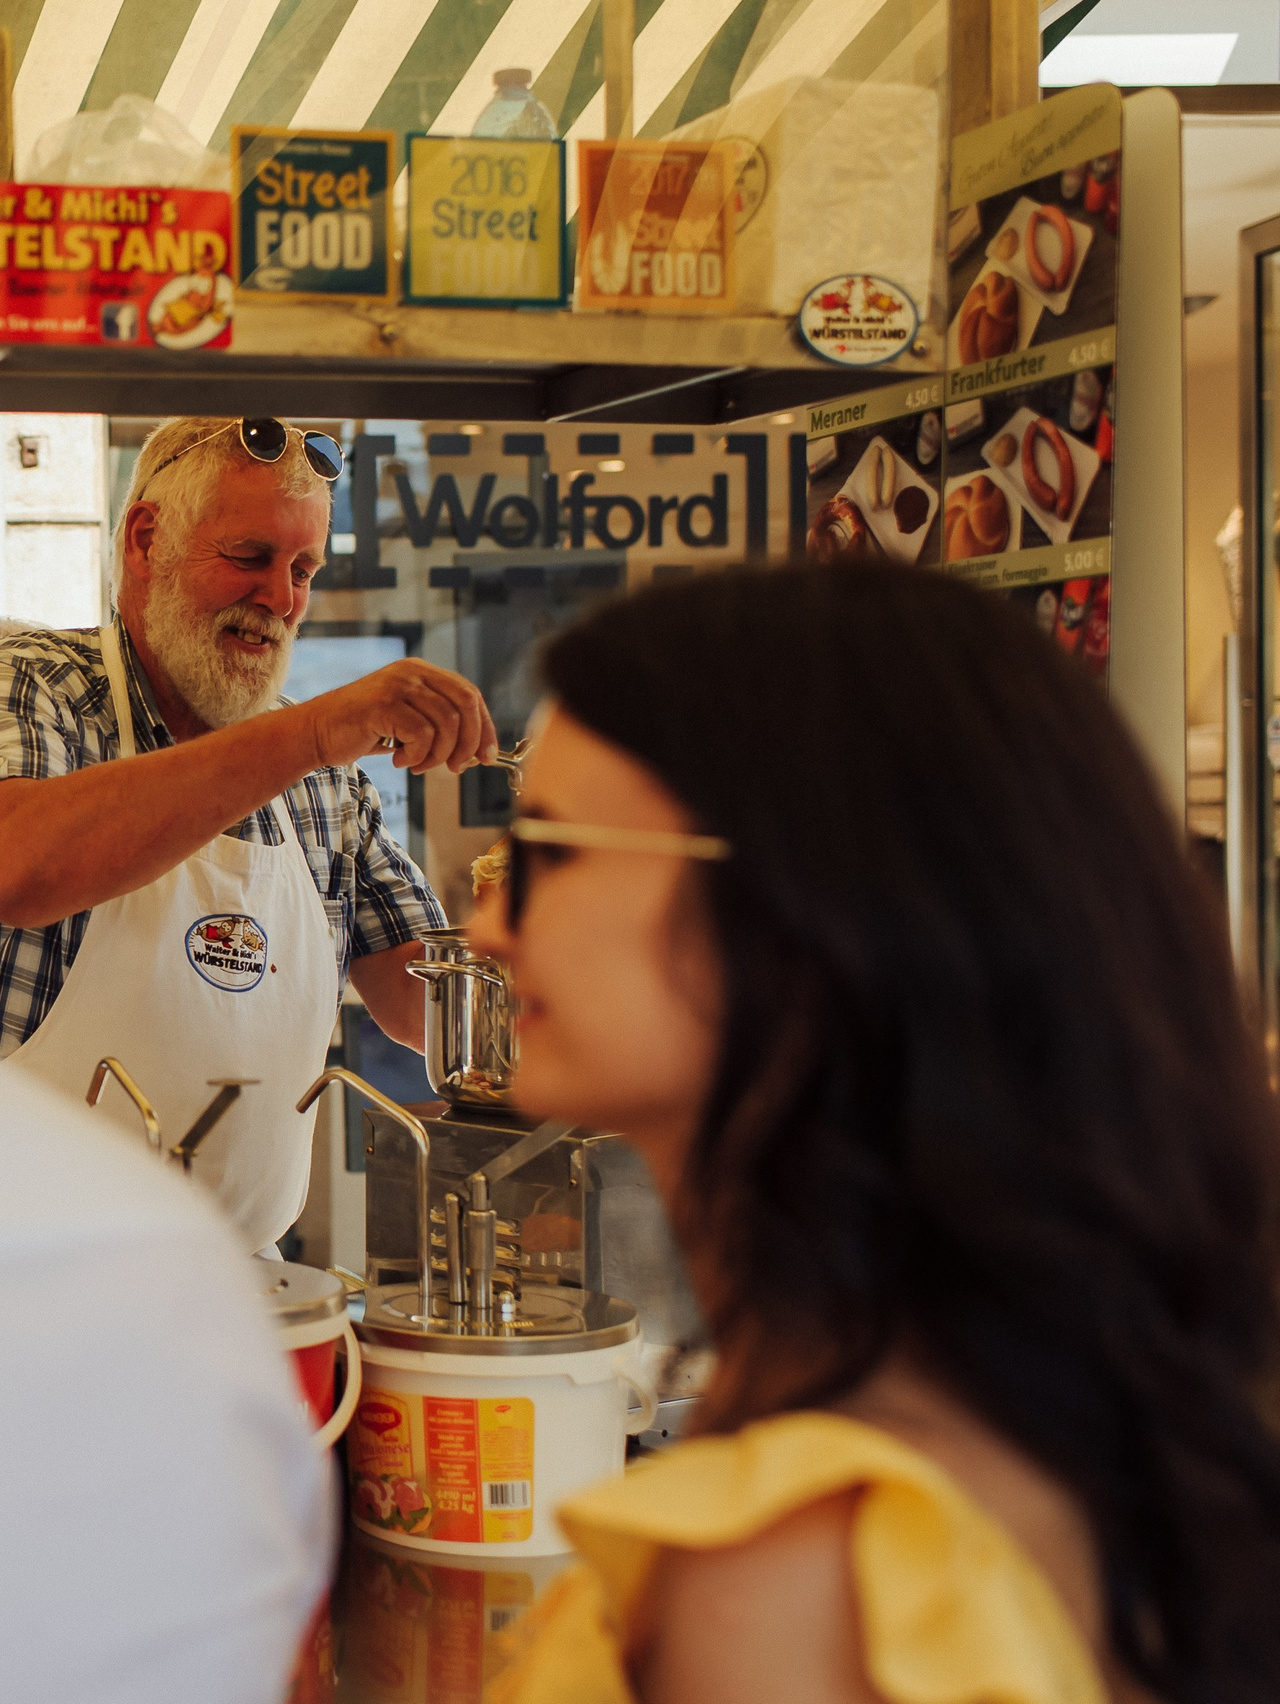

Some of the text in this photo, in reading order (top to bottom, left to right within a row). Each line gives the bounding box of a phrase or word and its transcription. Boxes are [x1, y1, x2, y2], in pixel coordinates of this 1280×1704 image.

[256, 158, 372, 209] Street
[450, 153, 529, 198] 2016
[24, 188, 53, 220] &
[431, 199, 539, 242] Street
[255, 209, 373, 270] FOOD
[631, 251, 722, 296] FOOD
[950, 354, 1046, 396] Frankfurter
[809, 402, 867, 433] Meraner
[394, 472, 728, 550] Wolford
[192, 949, 263, 974] WÜRSTELSTAND
[205, 943, 231, 957] Walter
[462, 1499, 476, 1515] kg
